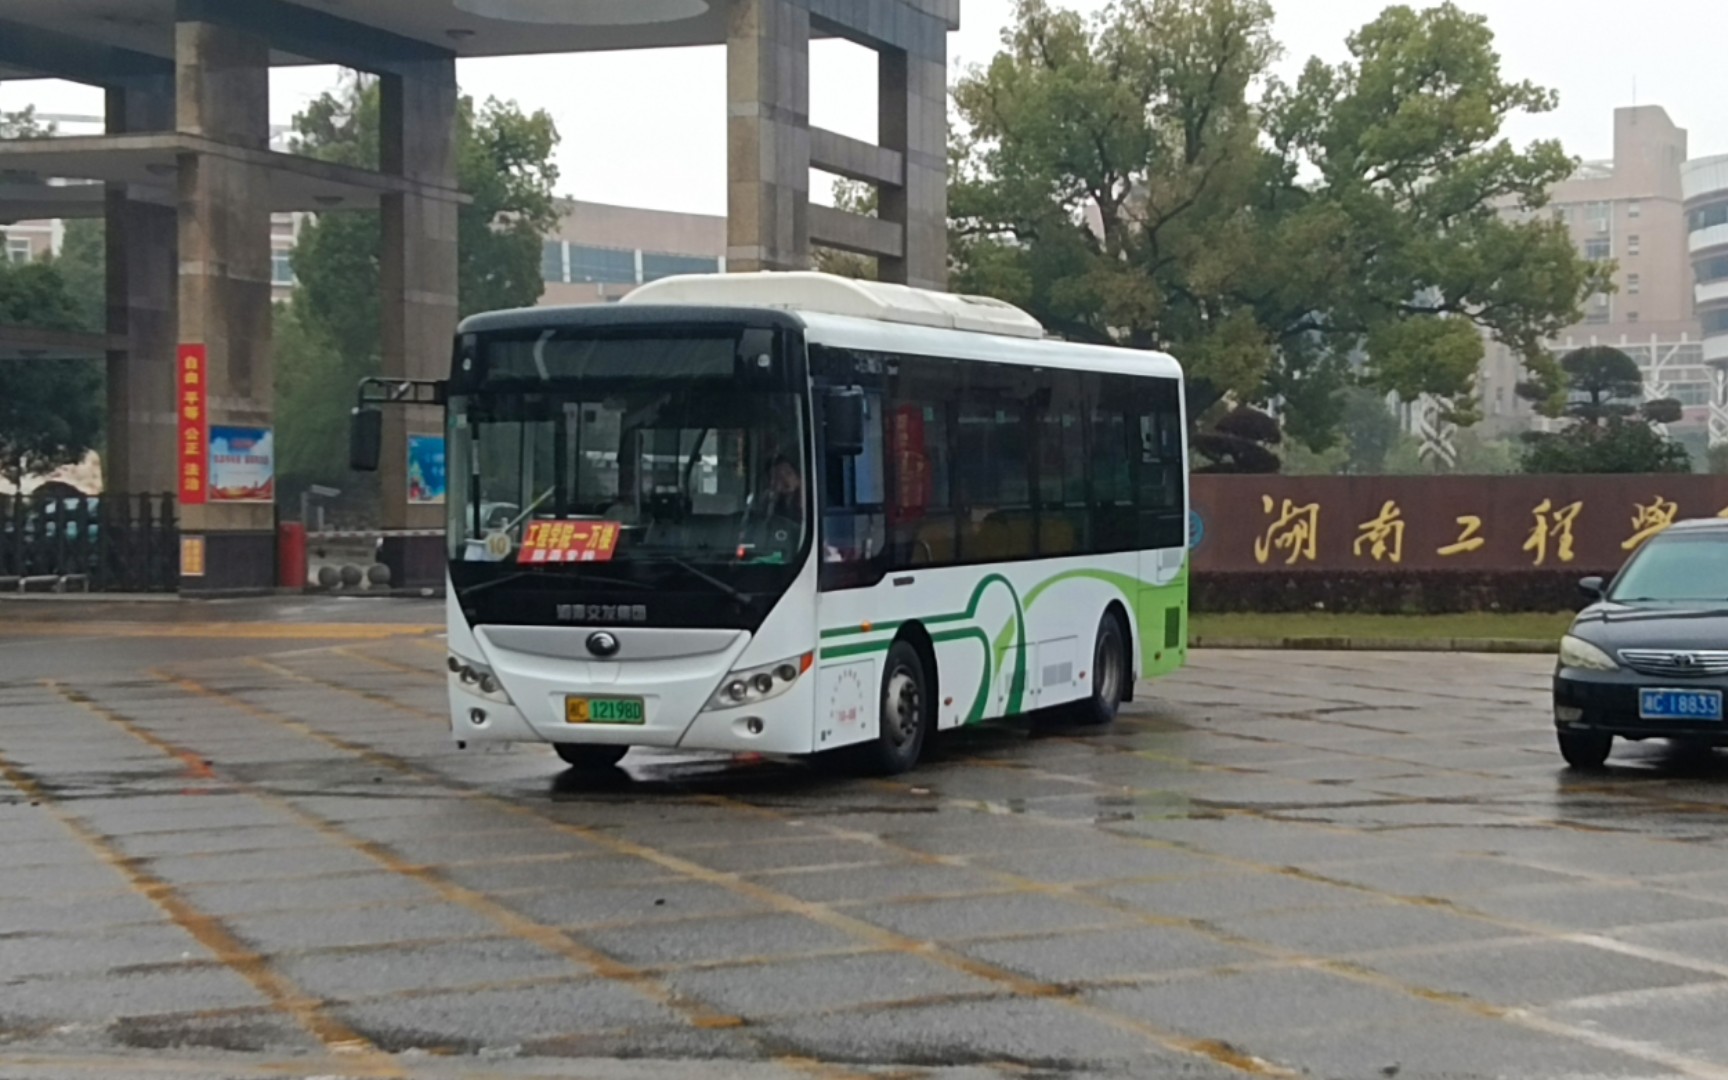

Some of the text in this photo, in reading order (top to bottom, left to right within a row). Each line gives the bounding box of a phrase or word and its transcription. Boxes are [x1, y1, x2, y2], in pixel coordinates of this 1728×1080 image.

[184, 356, 200, 491] 自由 平等 公正 法治
